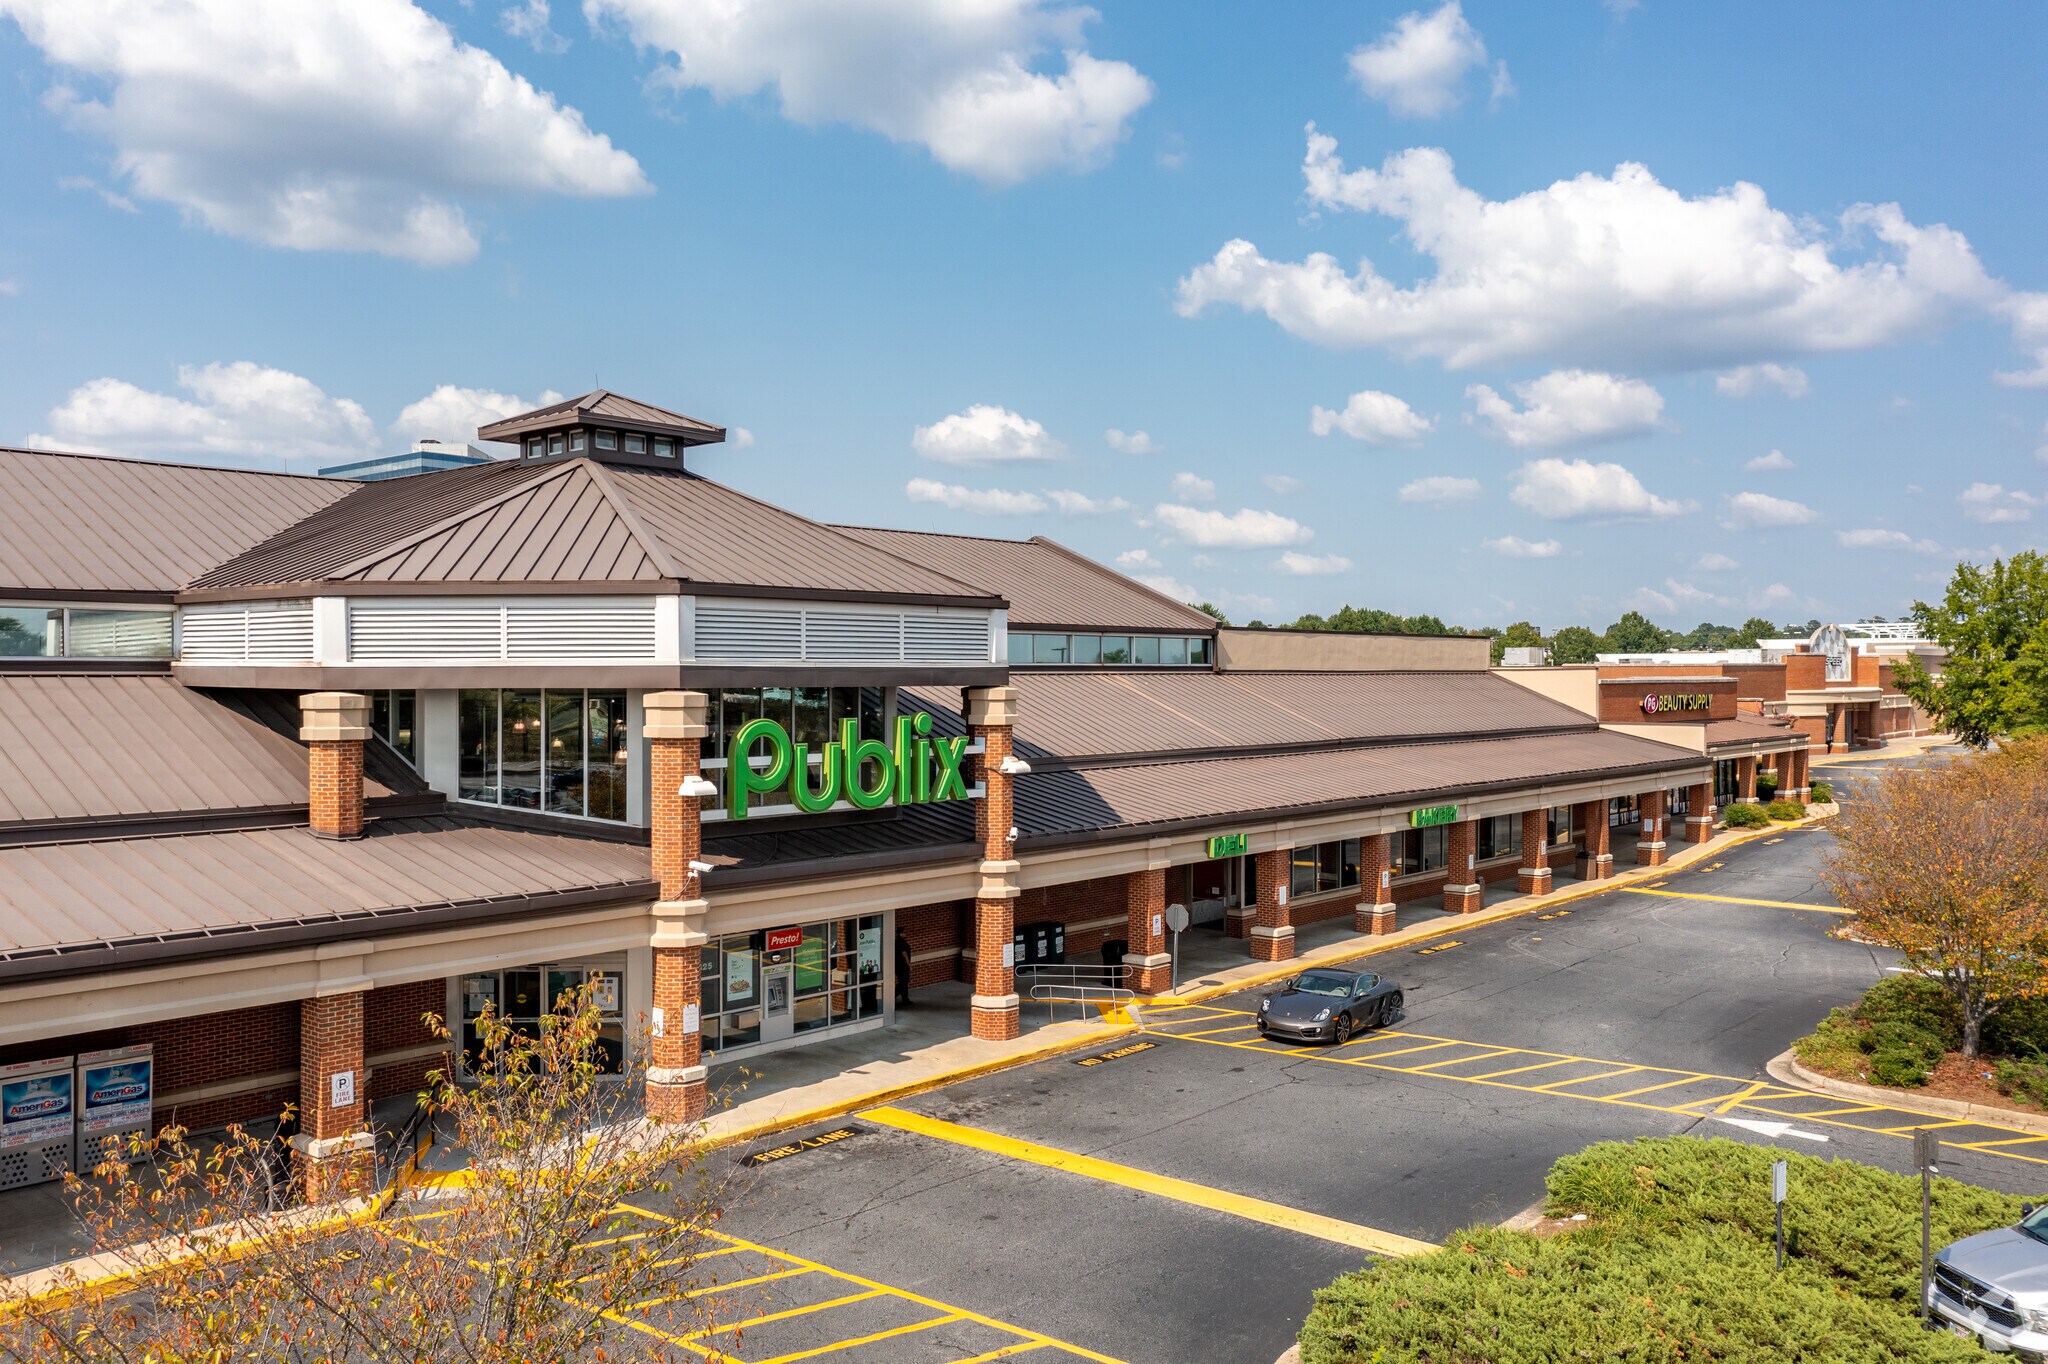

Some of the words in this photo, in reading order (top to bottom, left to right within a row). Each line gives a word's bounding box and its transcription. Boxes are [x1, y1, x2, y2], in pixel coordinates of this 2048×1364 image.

[1647, 697, 1656, 710] PG
[1659, 694, 1687, 711] BEAUTY
[1688, 694, 1713, 710] SUPPLY
[727, 712, 970, 820] Publix
[1411, 805, 1459, 828] BAKERY
[1208, 834, 1248, 859] DELI
[771, 932, 800, 946] Presto!
[1078, 1058, 1103, 1067] NO
[1100, 1042, 1156, 1060] PARKING
[93, 1085, 143, 1100] AmeriGas
[10, 1098, 64, 1115] AmeriGas
[753, 1146, 801, 1161] FIRE
[802, 1130, 855, 1147] LANE
